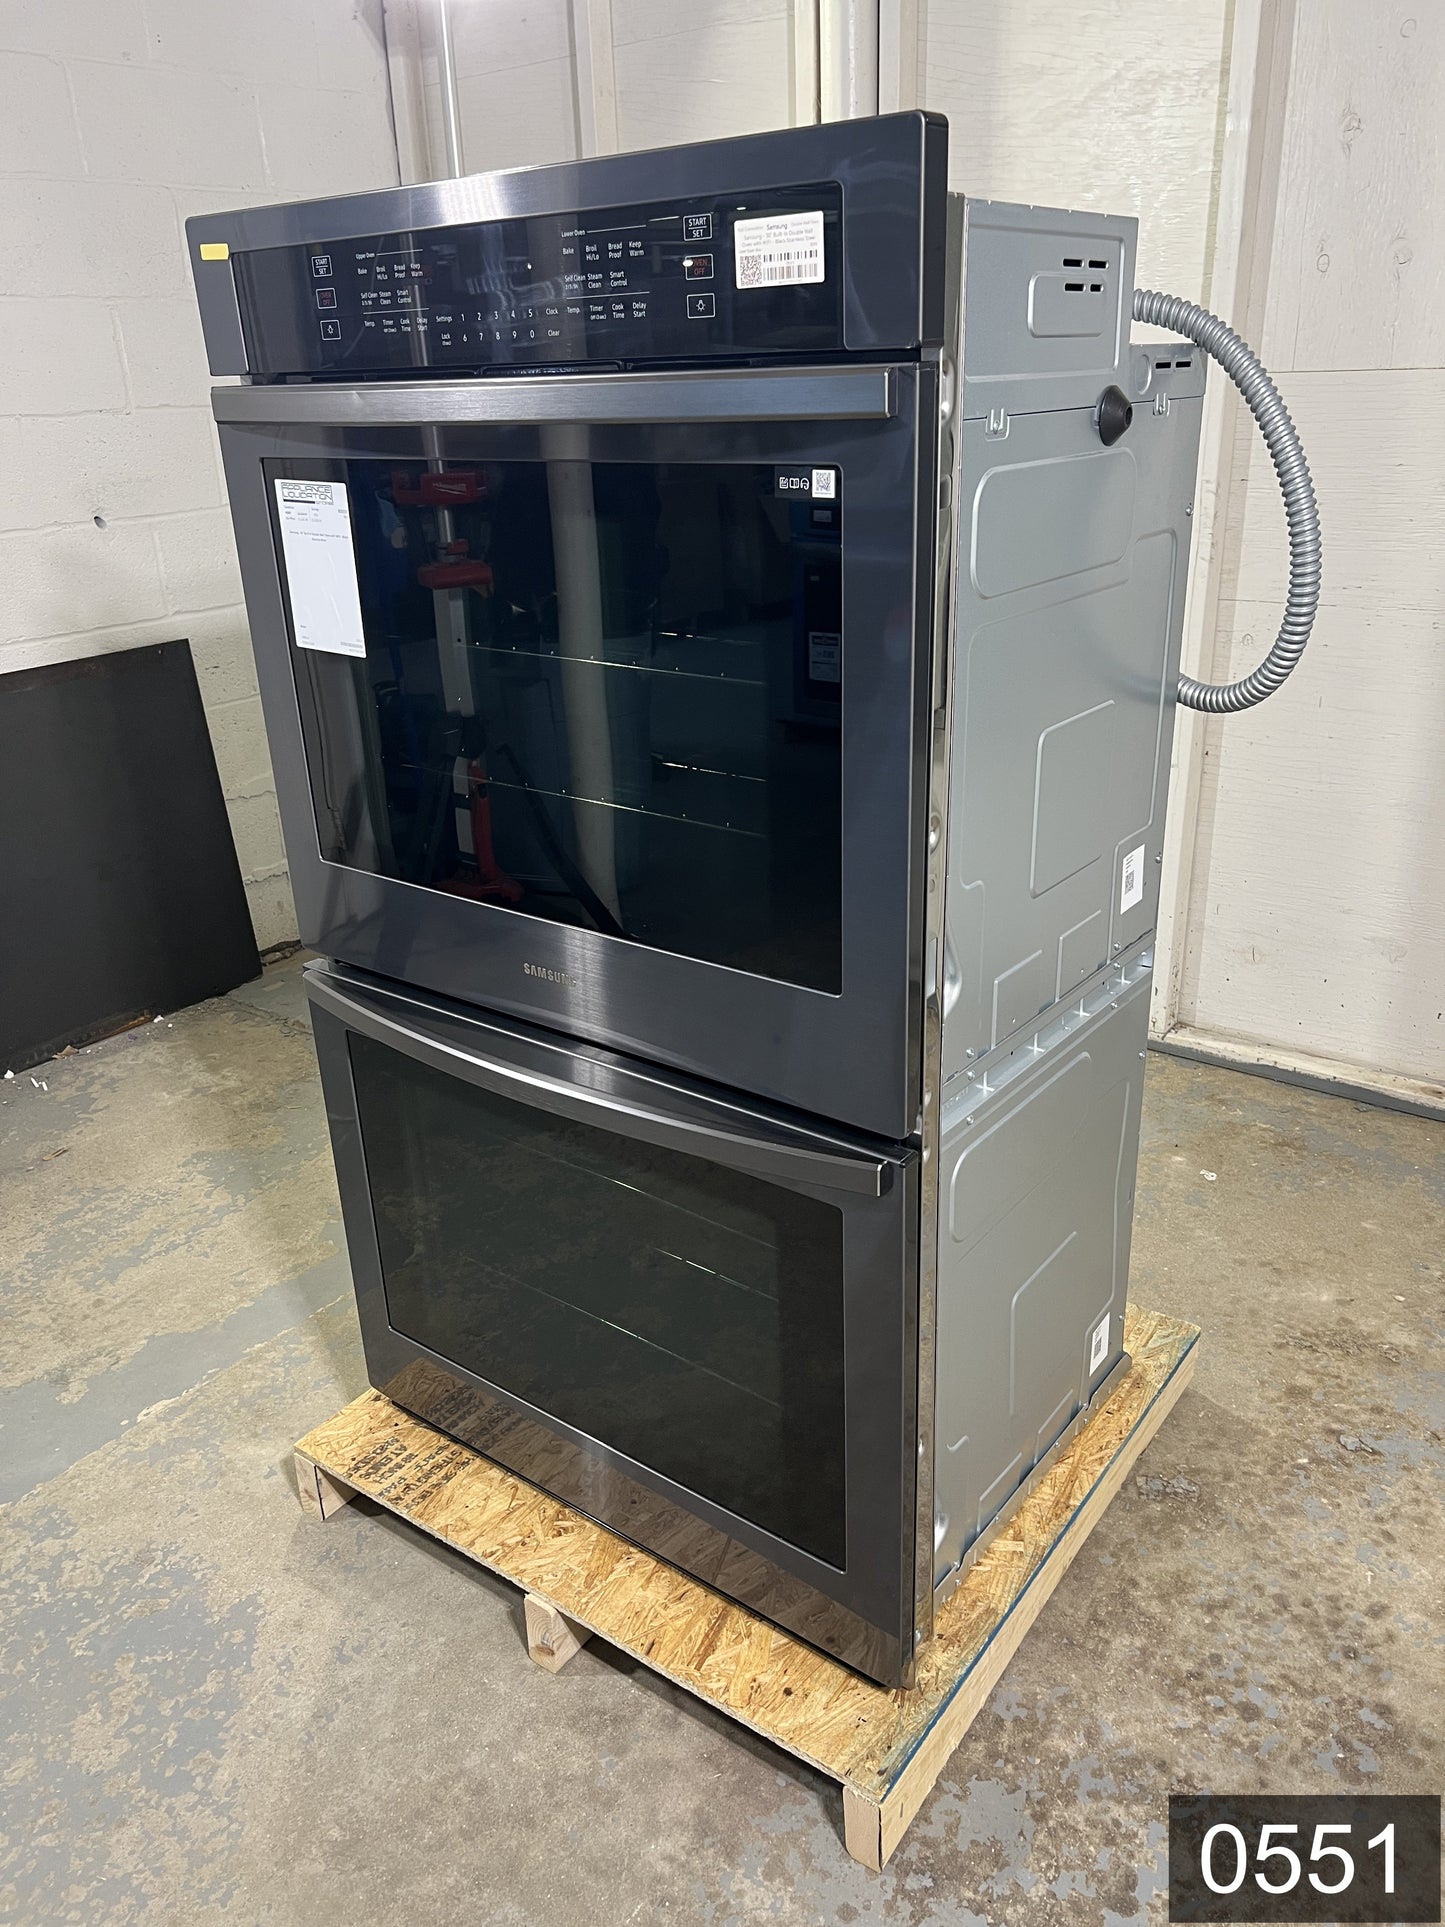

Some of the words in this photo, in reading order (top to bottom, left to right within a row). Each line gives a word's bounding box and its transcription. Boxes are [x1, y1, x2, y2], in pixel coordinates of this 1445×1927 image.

[688, 218, 706, 226] START
[692, 230, 704, 238] SET
[610, 279, 628, 287] Control
[632, 302, 647, 310] Delay
[478, 312, 482, 320] 2
[494, 311, 498, 320] 3
[511, 310, 516, 318] 4
[528, 309, 532, 318] 5
[496, 332, 500, 340] 8
[512, 330, 517, 338] 9
[530, 330, 534, 338] 0
